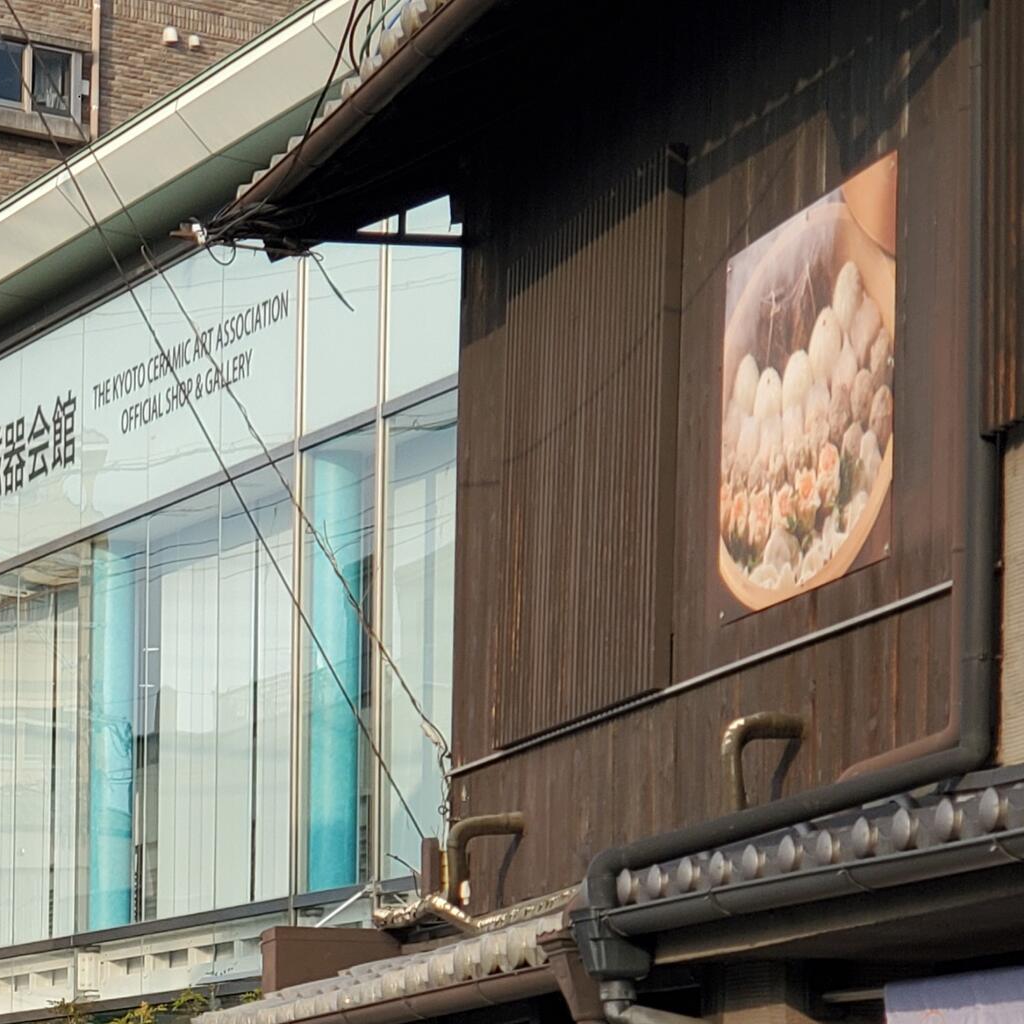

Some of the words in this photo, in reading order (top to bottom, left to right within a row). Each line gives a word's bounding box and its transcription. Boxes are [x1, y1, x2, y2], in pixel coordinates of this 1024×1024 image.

[93, 380, 110, 410] THE
[112, 362, 146, 401] KYOTO
[147, 338, 191, 384] CERAMIC
[193, 327, 214, 361] ART
[216, 290, 289, 351] ASSOCIATION
[121, 397, 164, 434] OFFICIAL
[166, 378, 193, 414] SHOP
[195, 373, 203, 400] &
[205, 348, 253, 395] GALLERY
